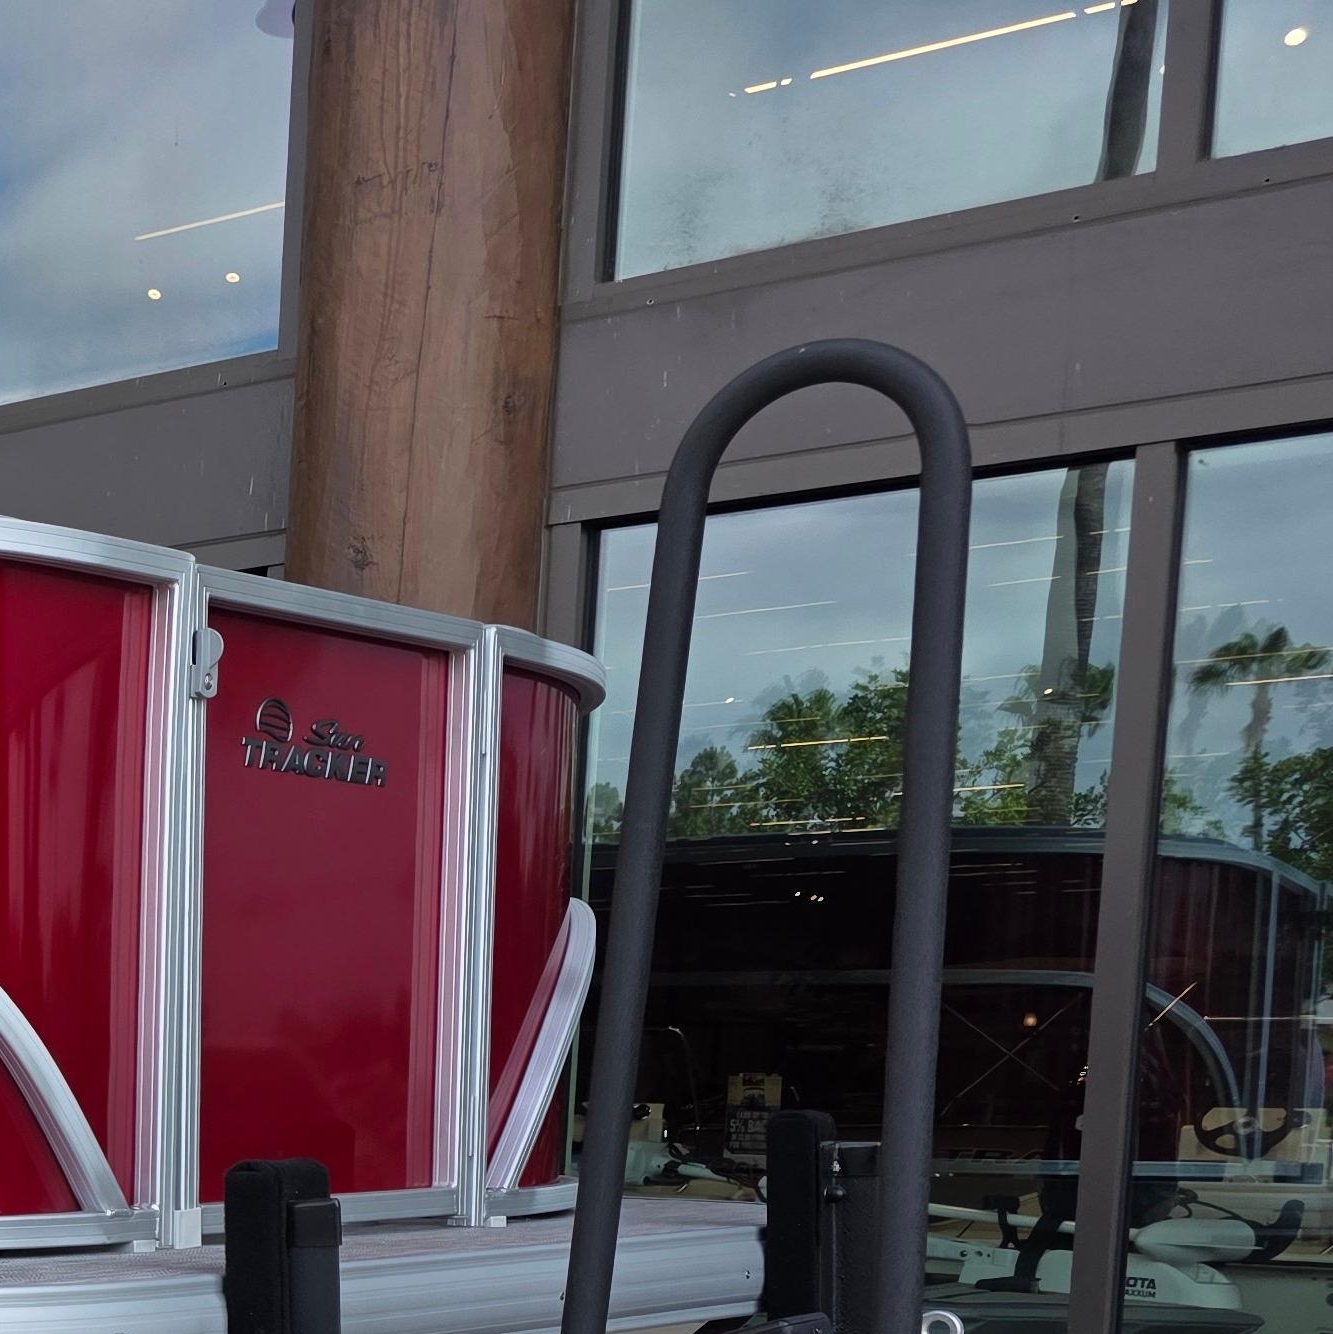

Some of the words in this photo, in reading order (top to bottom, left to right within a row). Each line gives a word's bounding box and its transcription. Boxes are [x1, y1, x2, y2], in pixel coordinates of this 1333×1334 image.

[301, 718, 365, 752] Sun
[241, 736, 389, 787] TRACKER
[1124, 1276, 1157, 1290] OTA
[1124, 1289, 1157, 1298] AXXUM
